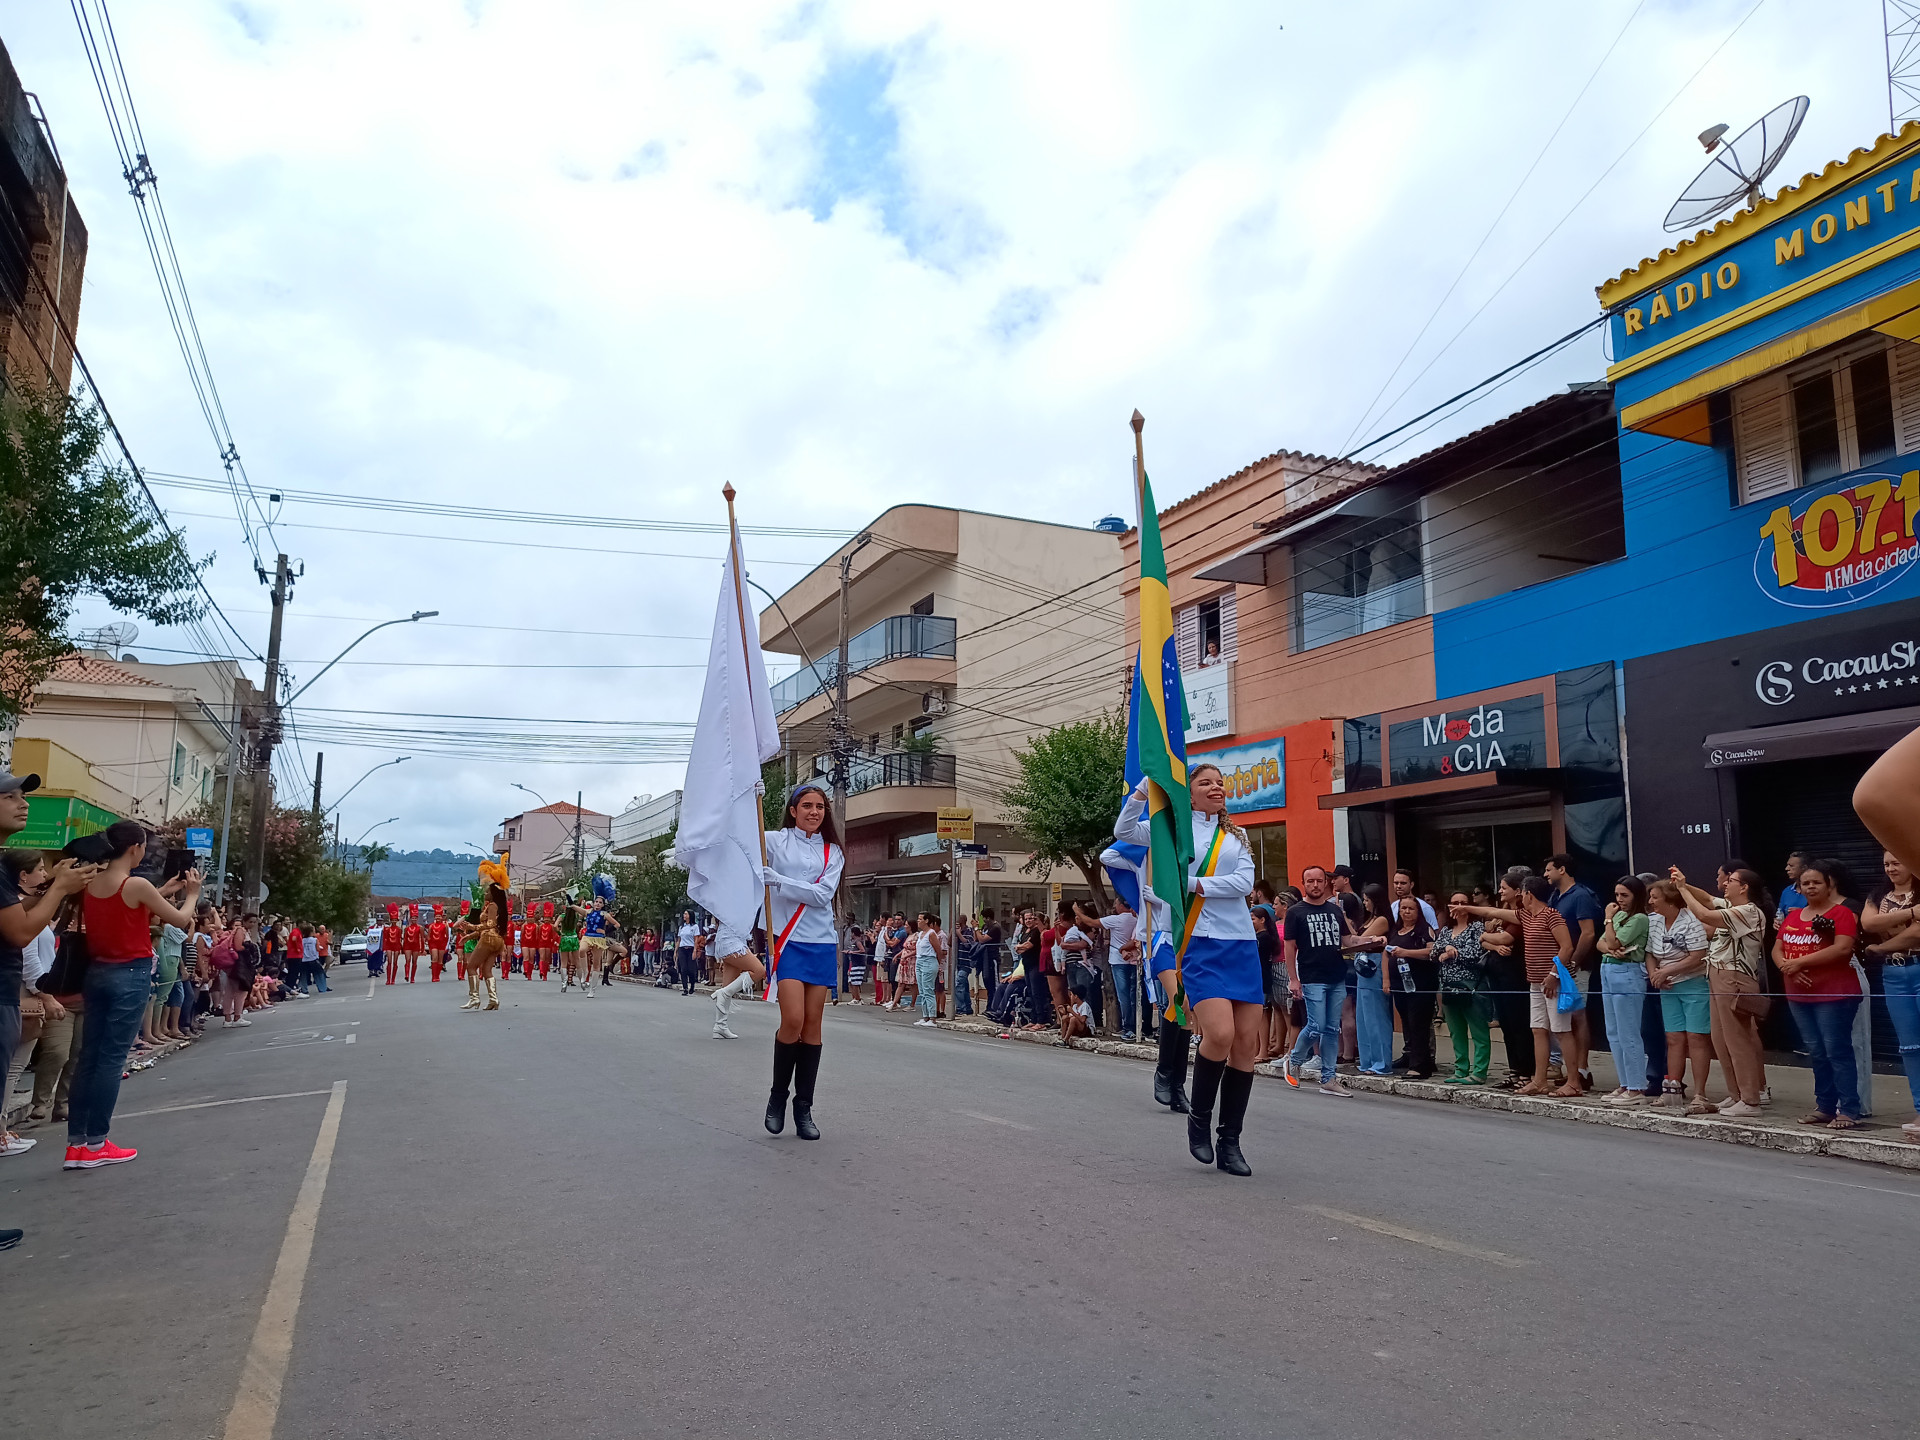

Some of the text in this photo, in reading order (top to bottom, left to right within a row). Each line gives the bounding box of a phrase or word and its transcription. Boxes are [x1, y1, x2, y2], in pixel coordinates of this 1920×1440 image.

[1624, 261, 1740, 336] RÁDIO
[1760, 470, 1920, 587] 107.1
[1855, 560, 1873, 581] da
[1875, 540, 1920, 573] cidad
[1211, 719, 1227, 730] Ribeiro
[1441, 740, 1507, 774] & CIA
[1680, 823, 1710, 834] 186B
[1306, 913, 1328, 922] CRAFT
[1308, 921, 1331, 932] BEER
